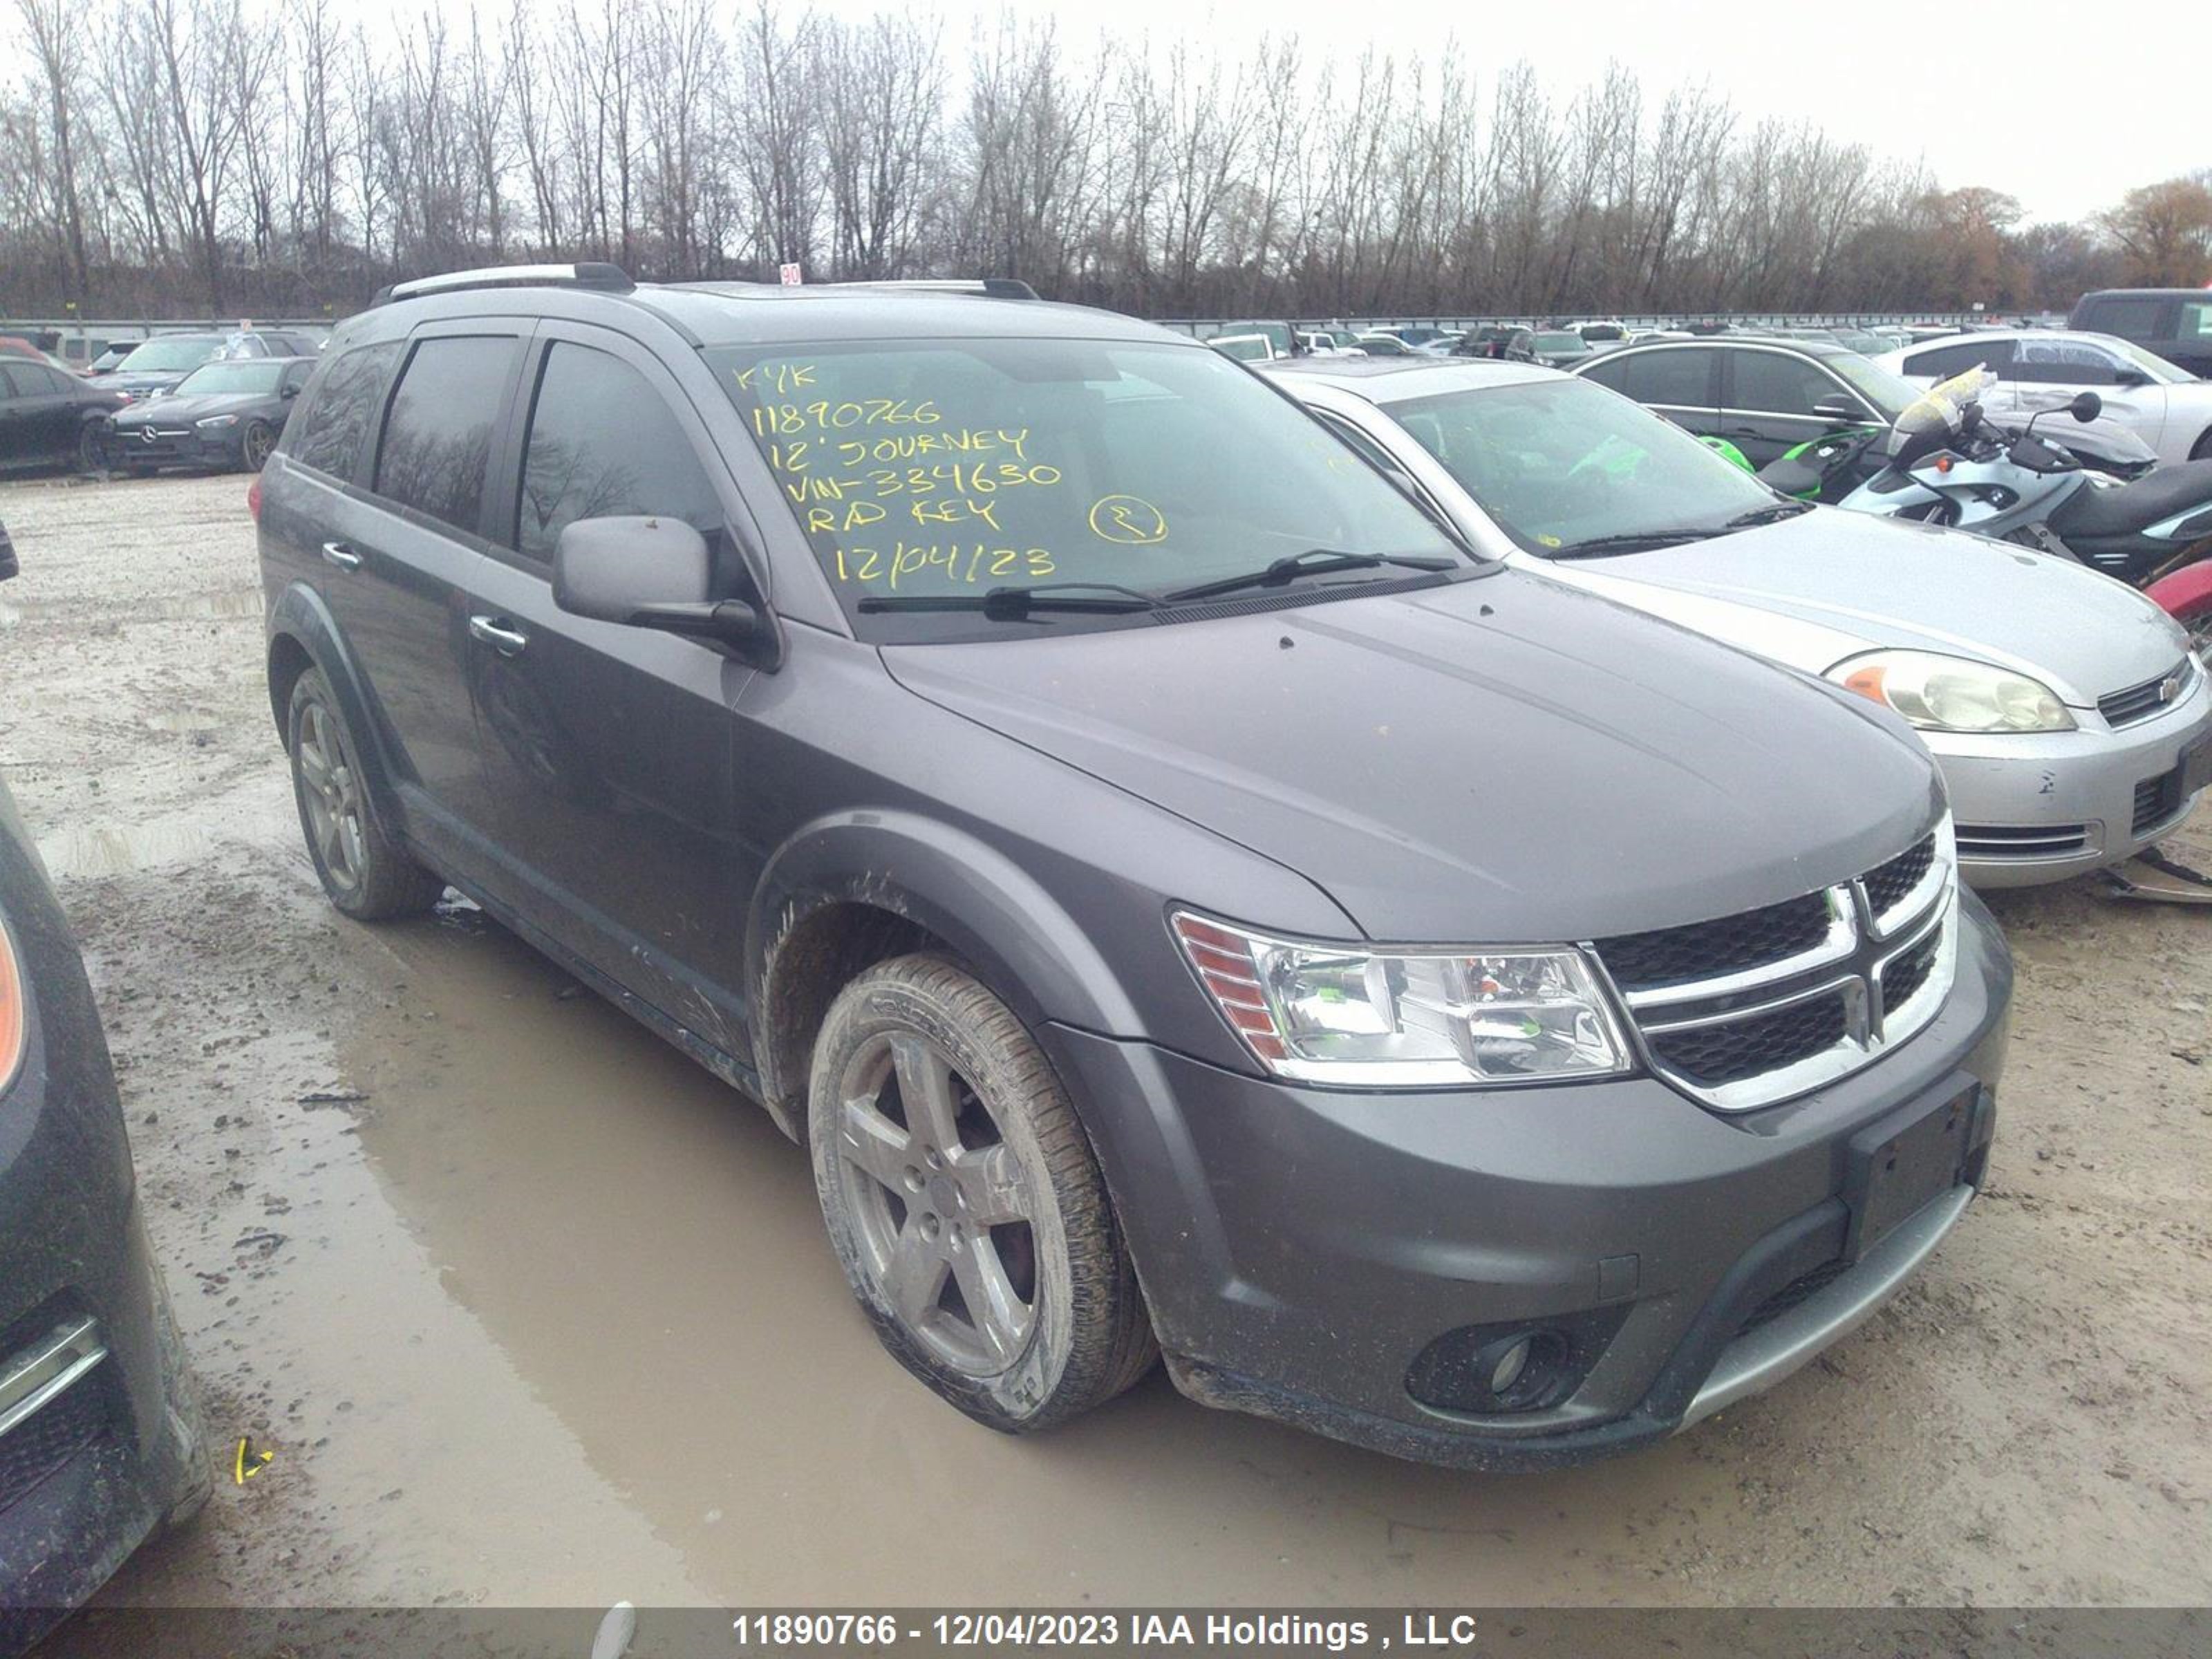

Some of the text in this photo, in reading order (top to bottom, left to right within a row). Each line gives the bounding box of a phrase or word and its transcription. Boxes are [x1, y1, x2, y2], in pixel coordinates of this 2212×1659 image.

[753, 400, 941, 436] 11890766
[838, 429, 1029, 467] JOURNEY
[911, 499, 1002, 531] KEY
[836, 542, 1056, 590] 12/04/23
